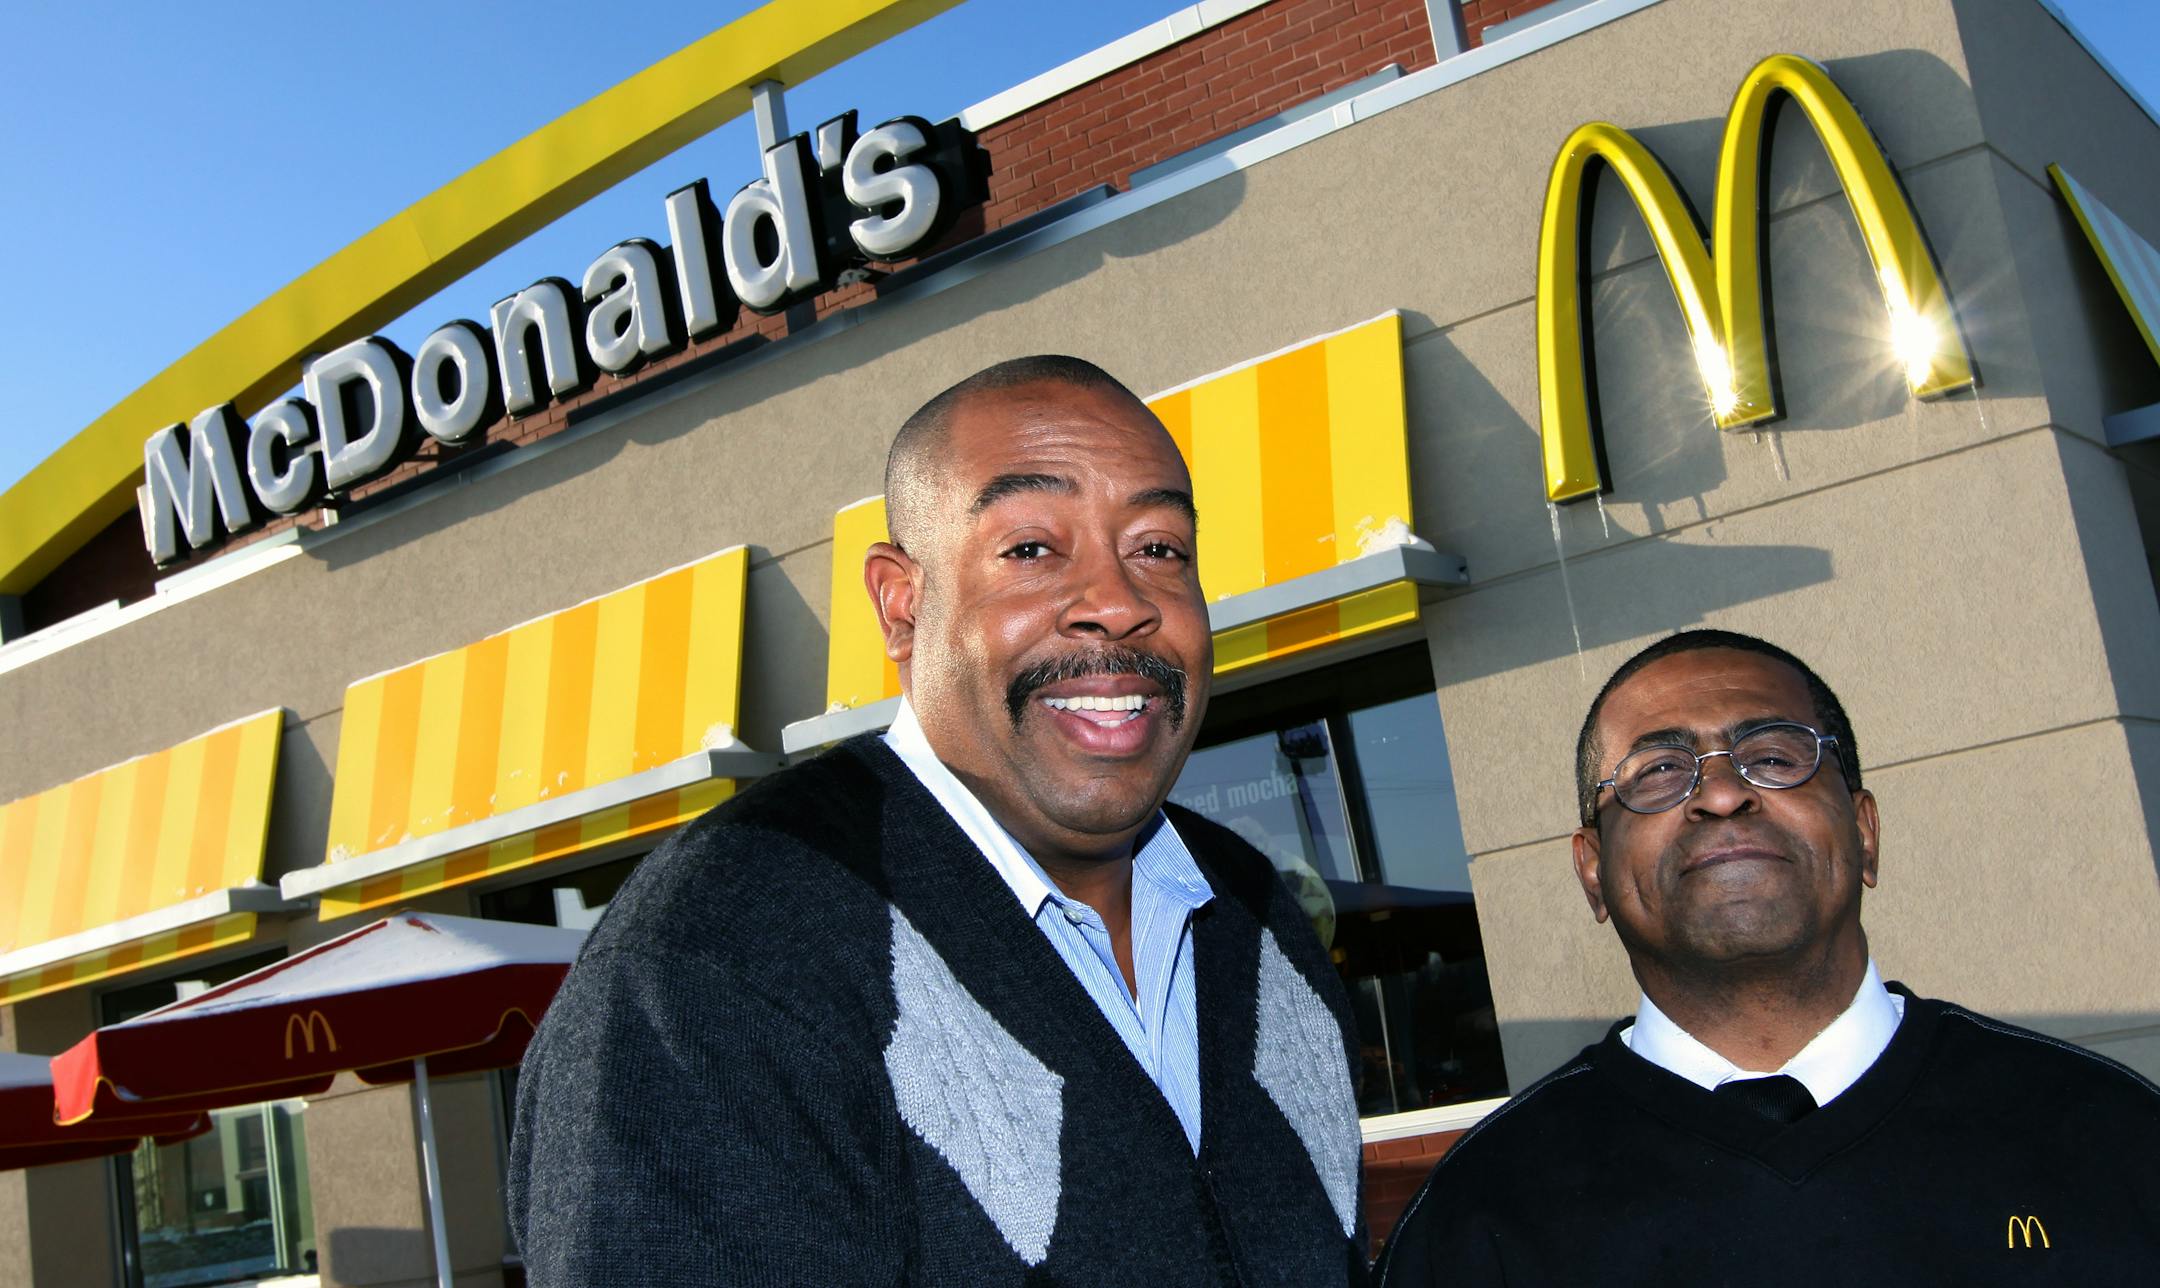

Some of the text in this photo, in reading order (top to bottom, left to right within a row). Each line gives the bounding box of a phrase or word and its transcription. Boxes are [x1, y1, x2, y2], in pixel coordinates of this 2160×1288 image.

[143, 112, 942, 567] McDonald's
[1174, 769, 1299, 815] ced mocha
